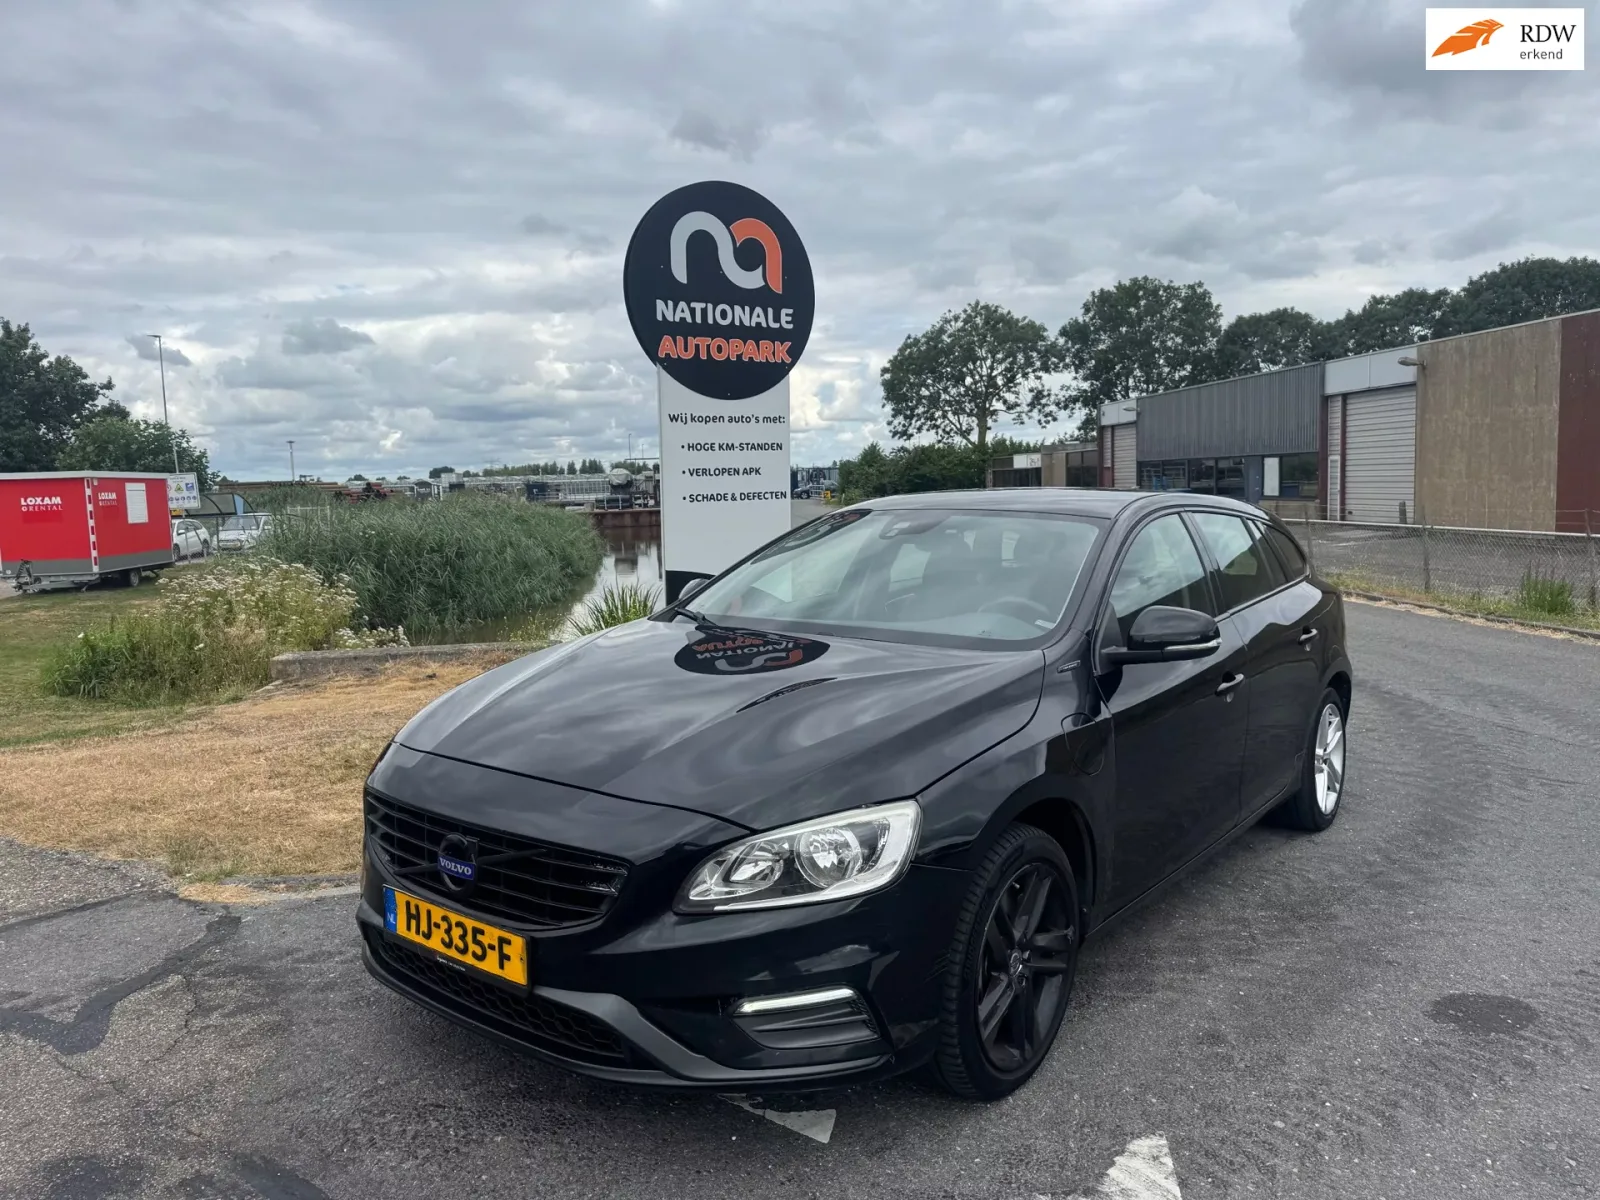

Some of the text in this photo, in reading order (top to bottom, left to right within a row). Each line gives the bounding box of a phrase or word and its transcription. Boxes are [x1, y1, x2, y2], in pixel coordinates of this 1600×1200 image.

[656, 299, 794, 329] NATIONALE
[658, 335, 792, 363] AUTOPARK
[668, 413, 786, 425] Wij kopen auto's met:
[687, 442, 783, 452] HOGE KM-STANDEN
[688, 467, 762, 477] VERLOPEN APK
[20, 496, 62, 506] LOXAM
[98, 492, 117, 500] LOXAM
[688, 491, 787, 503] SCHADE & DEFECTEN
[439, 857, 472, 876] VOLVO
[386, 911, 396, 925] NL
[405, 900, 512, 970] HJ-335-F
